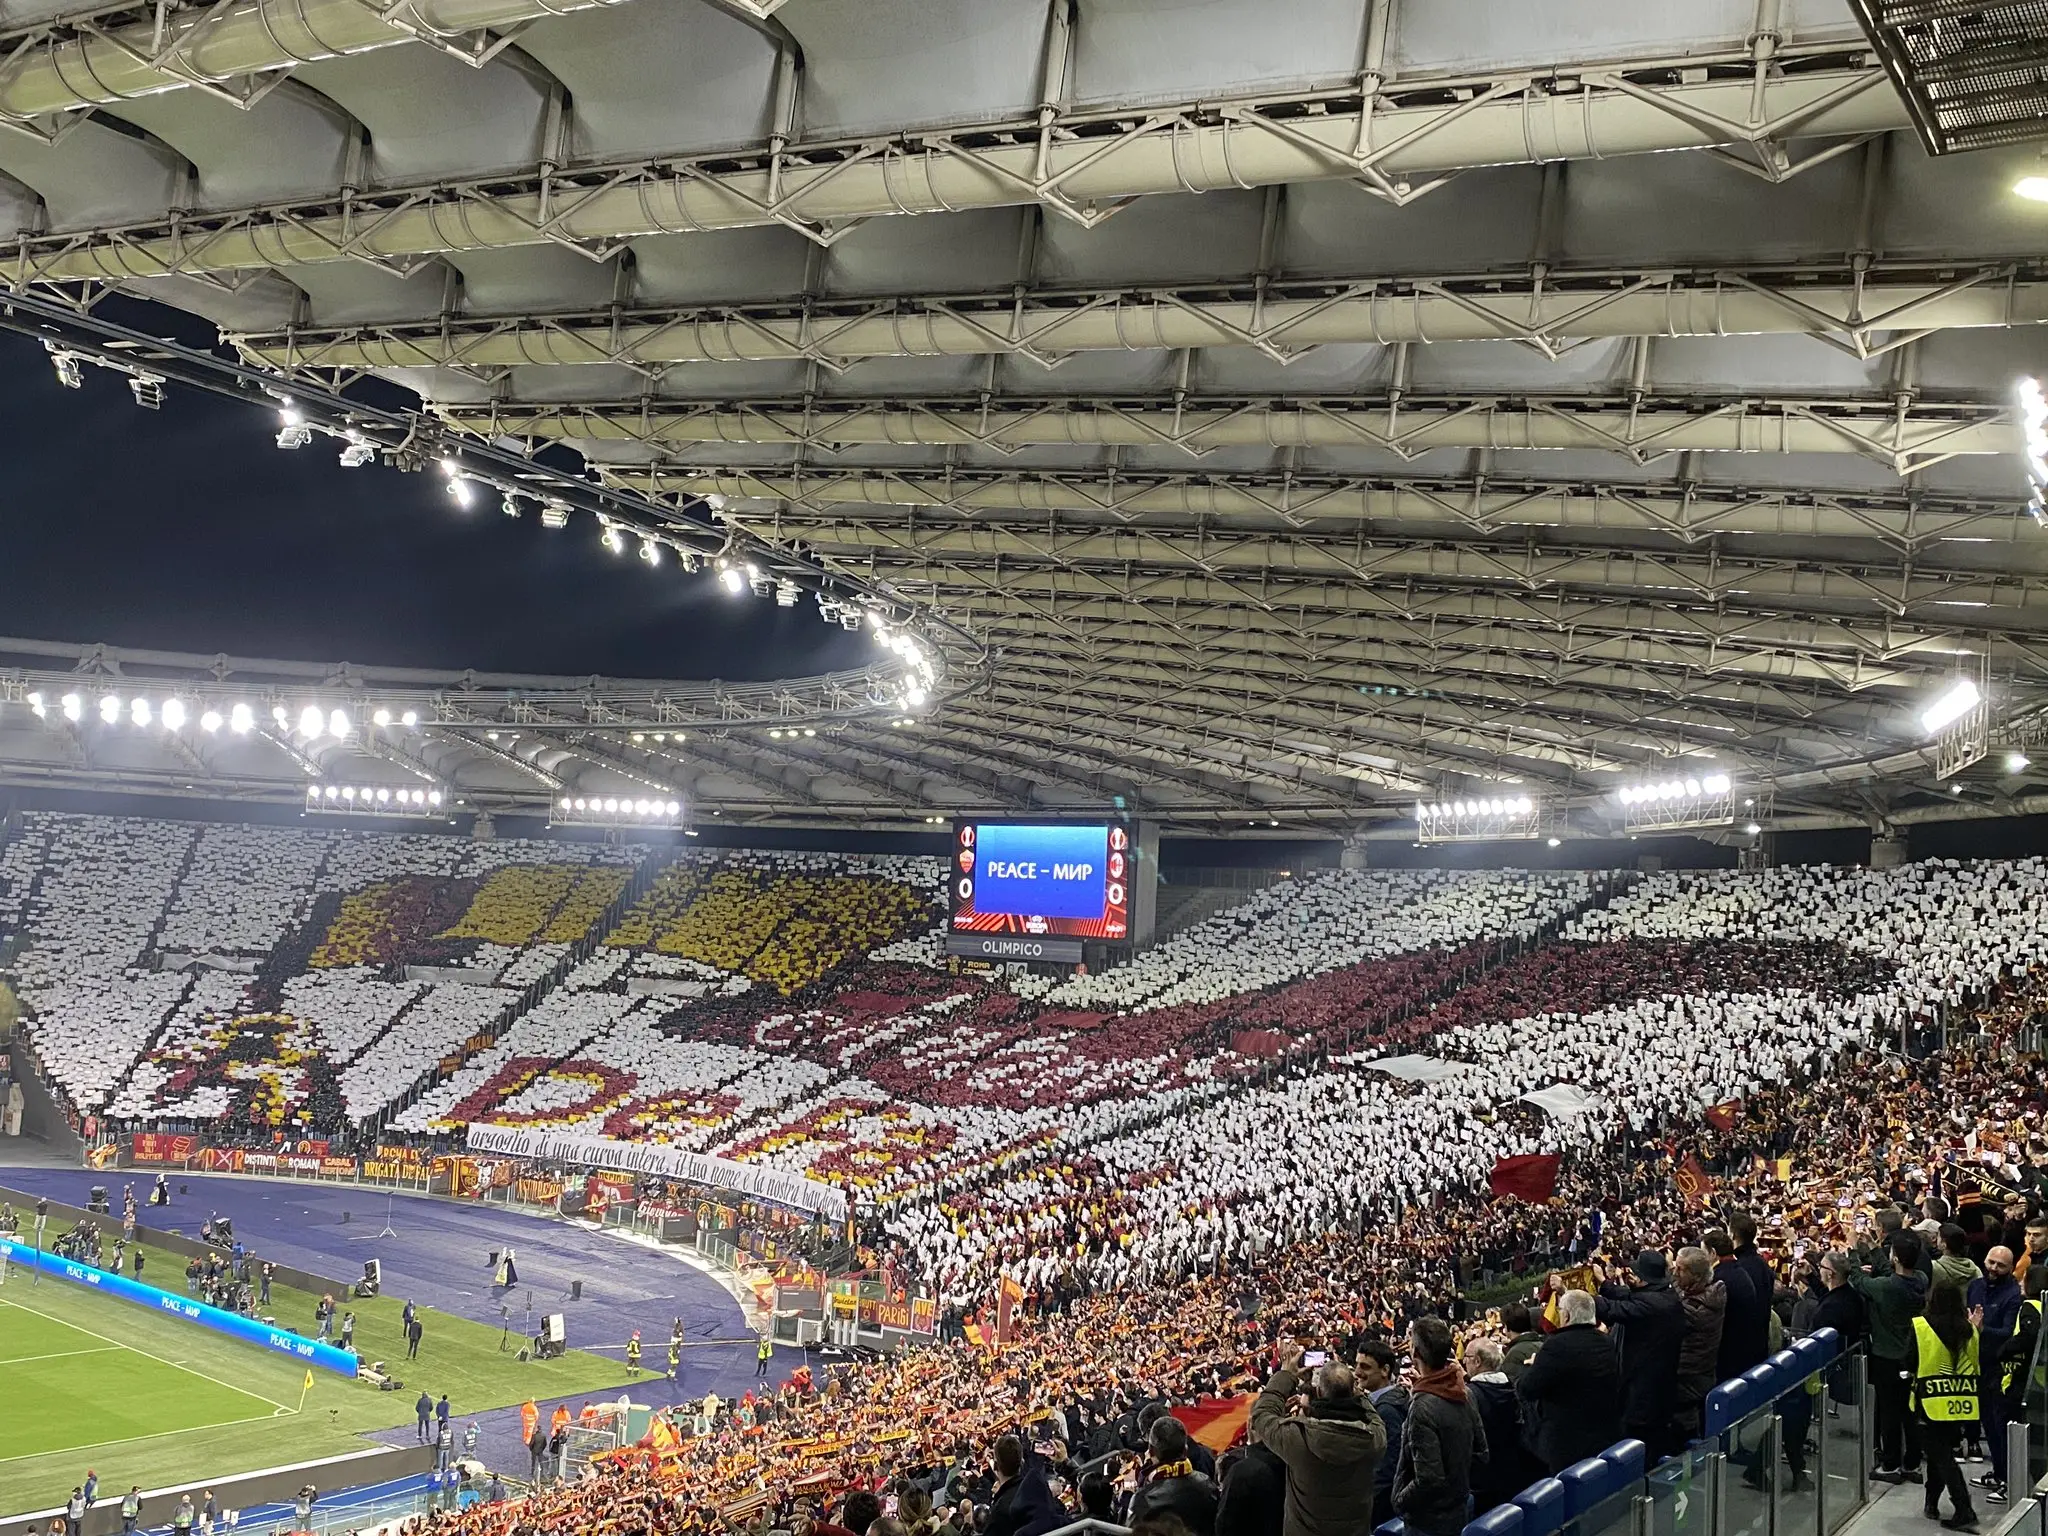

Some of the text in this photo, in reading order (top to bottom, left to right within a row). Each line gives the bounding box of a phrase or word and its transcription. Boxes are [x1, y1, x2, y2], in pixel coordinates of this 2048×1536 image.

[988, 861, 1037, 879] PEACE
[1053, 863, 1093, 881] МИР
[959, 878, 973, 899] 0
[1109, 883, 1124, 905] 0
[982, 940, 1043, 957] OLIMPICO
[968, 961, 991, 970] ROMA
[244, 1153, 320, 1170] DISTINTI ROMANI
[364, 1161, 400, 1178] BRIGATA
[471, 1130, 530, 1154] orgoglio
[535, 1134, 551, 1157] di
[553, 1142, 580, 1161] una
[583, 1145, 623, 1167] curva
[674, 1152, 687, 1175] il
[688, 1155, 708, 1180] tuo
[710, 1163, 741, 1189] nome
[753, 1168, 765, 1193] la
[767, 1175, 800, 1203] nostra
[66, 1264, 84, 1279] PEACE
[161, 1297, 180, 1311] PEACE
[914, 1301, 933, 1317] AVE
[270, 1333, 292, 1350] PEACE
[1947, 1400, 1973, 1415] 209
